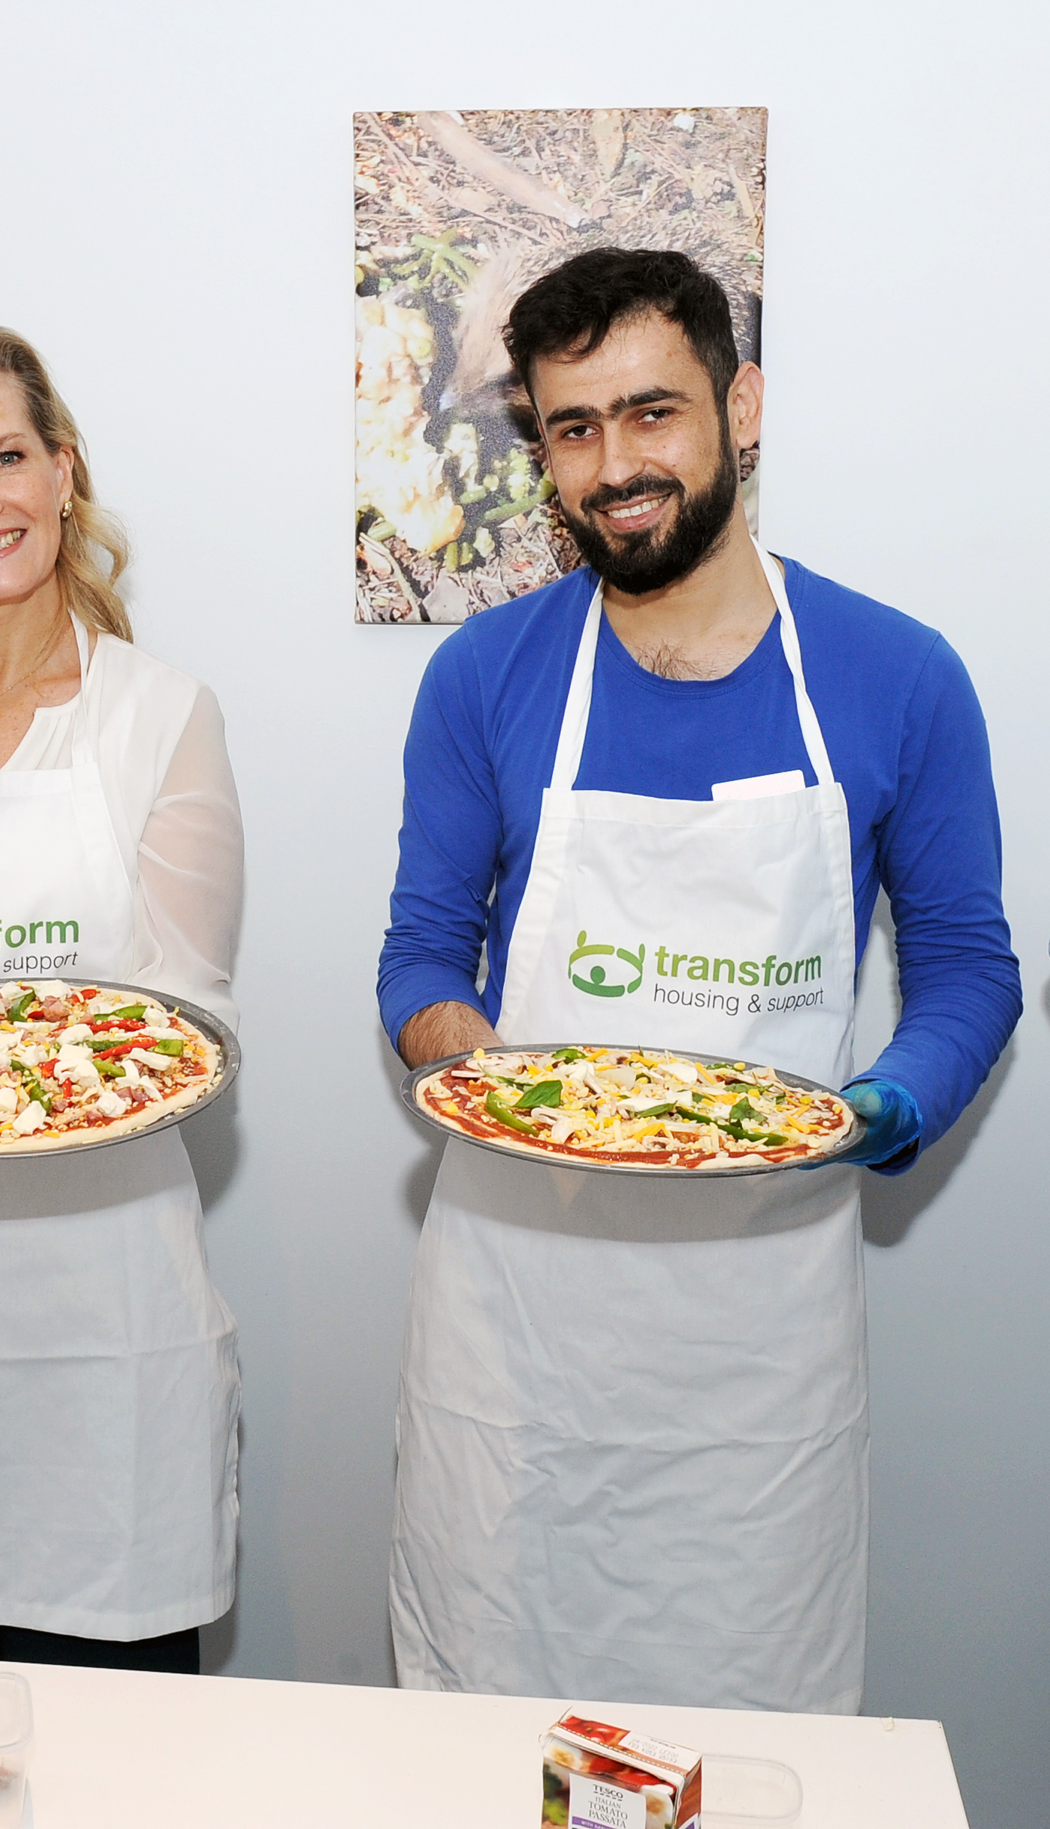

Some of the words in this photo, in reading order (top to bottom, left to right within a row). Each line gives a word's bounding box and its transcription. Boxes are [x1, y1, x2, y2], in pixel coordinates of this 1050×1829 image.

[3, 951, 79, 974] support
[654, 945, 823, 987] transform
[653, 983, 740, 1016] housing
[747, 993, 762, 1013] &
[767, 987, 825, 1013] support
[593, 1784, 623, 1799] TESCO
[588, 1800, 628, 1820] TOMATO
[595, 1796, 621, 1809] ITALIAN
[588, 1809, 627, 1829] PASSATA
